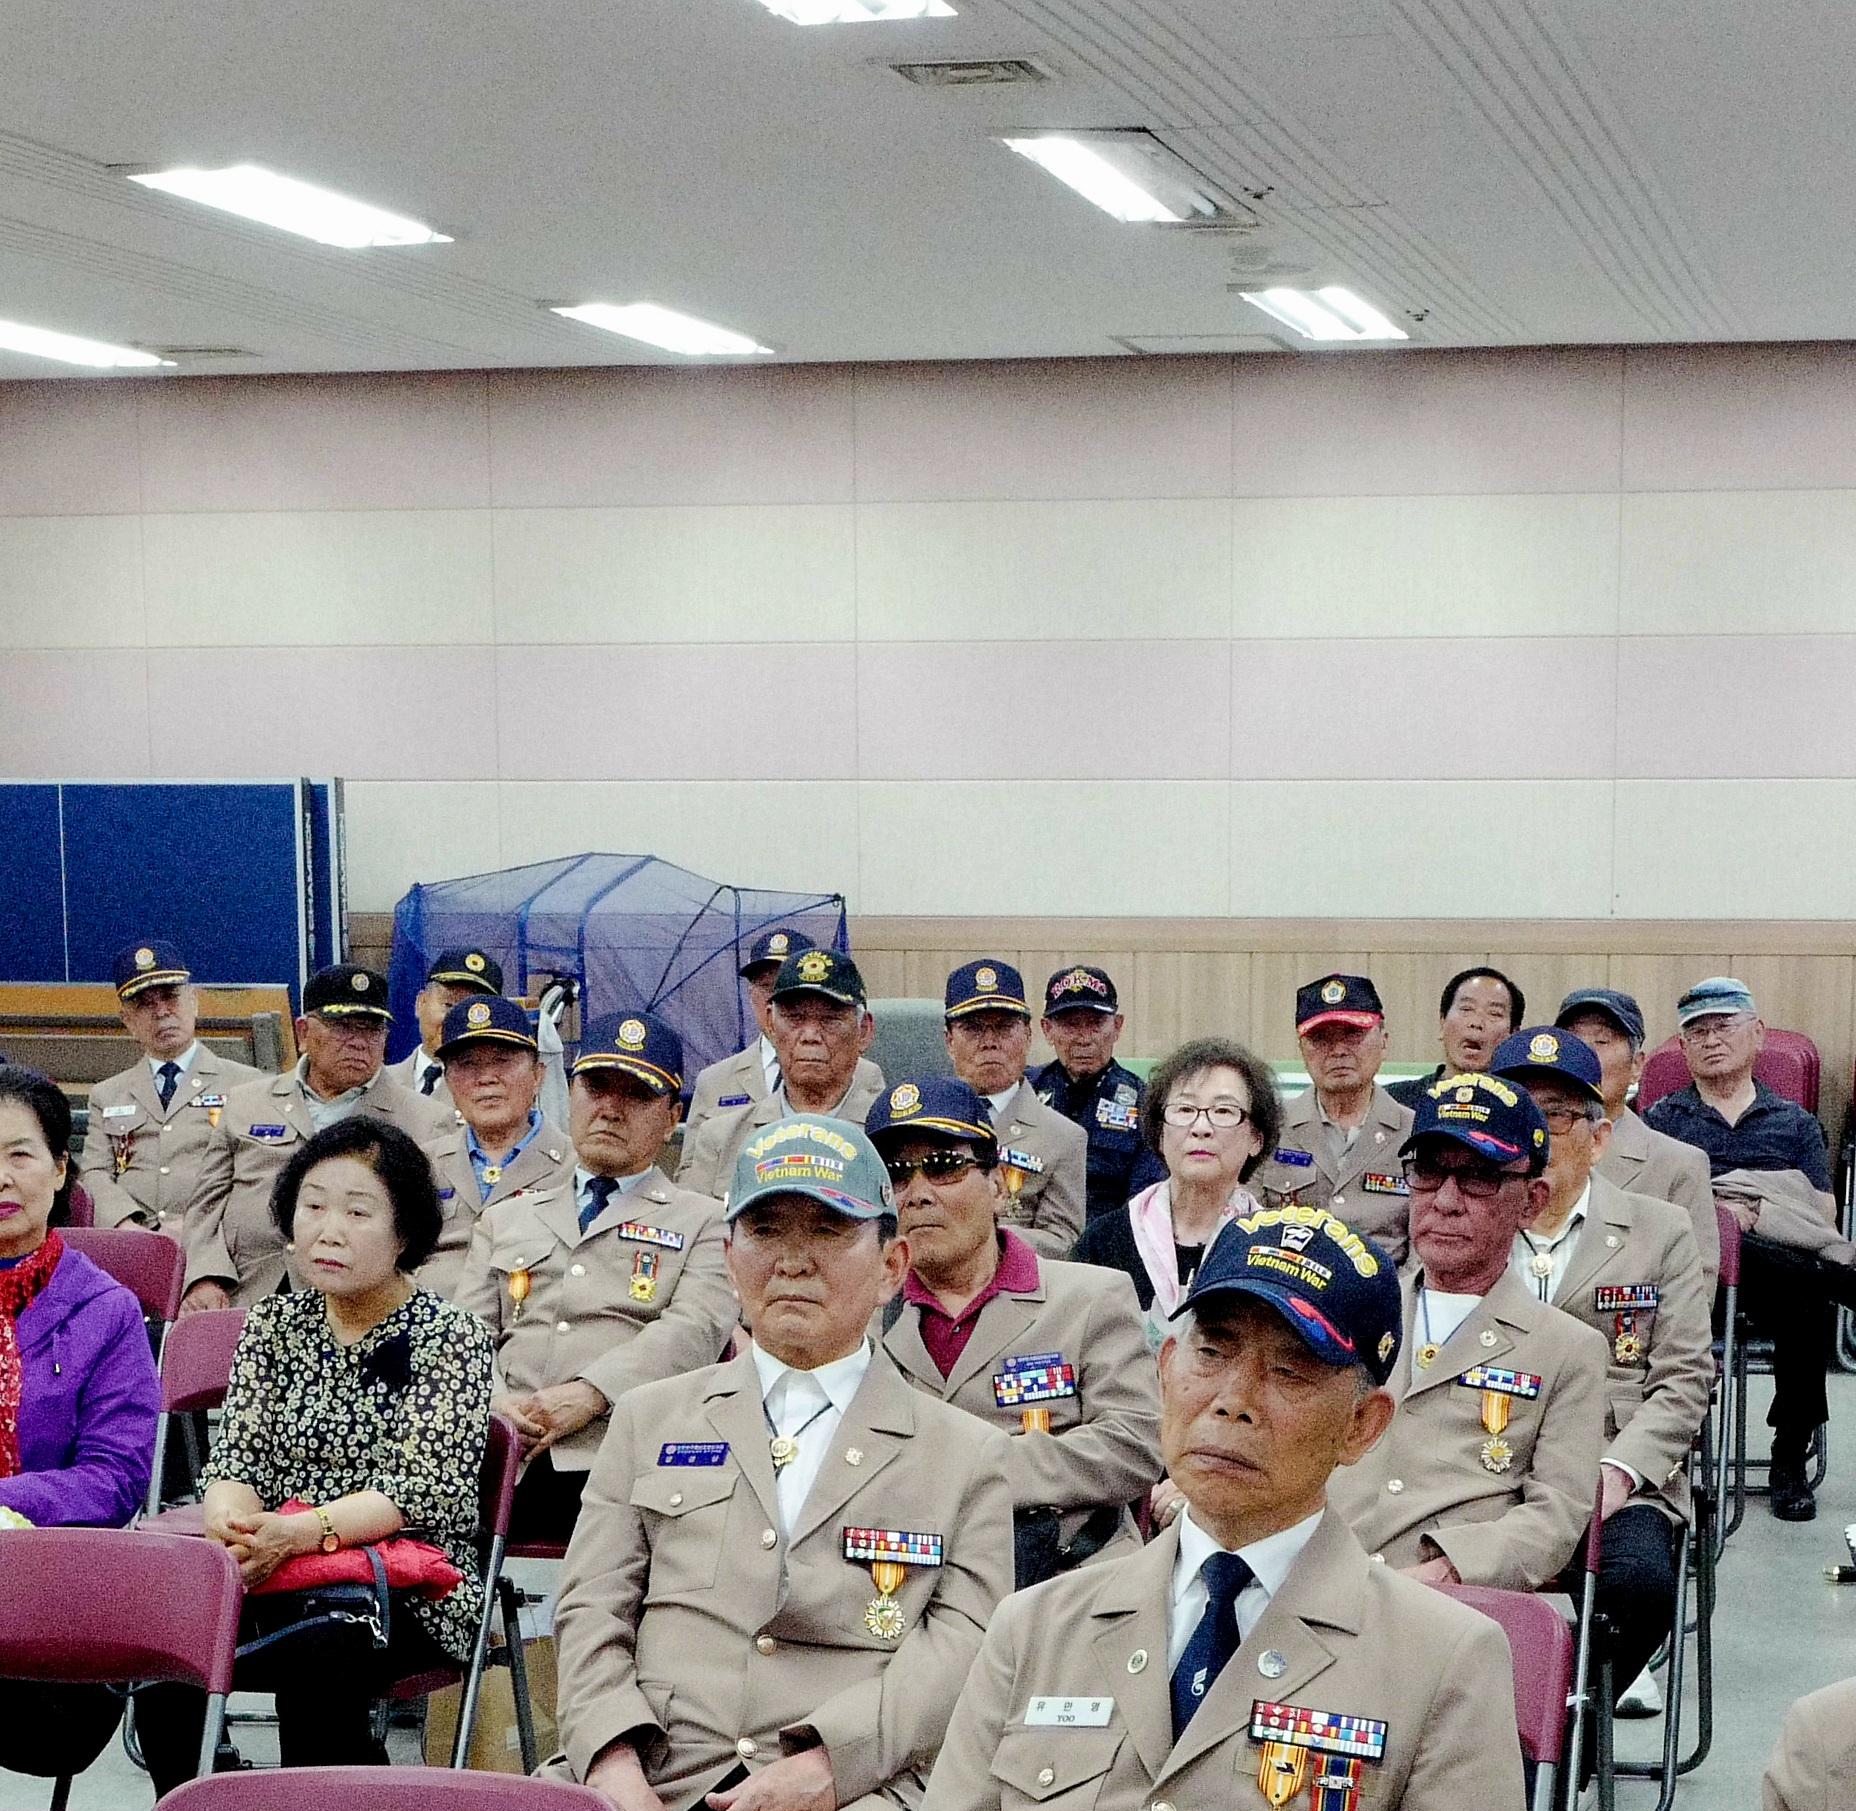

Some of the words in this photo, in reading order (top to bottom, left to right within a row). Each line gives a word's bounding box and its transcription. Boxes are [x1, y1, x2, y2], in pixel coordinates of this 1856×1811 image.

[746, 1123, 857, 1160] Veterans
[757, 1166, 812, 1184] Vietnam
[814, 1166, 843, 1182] War
[1236, 1205, 1378, 1278] Veterans
[1247, 1254, 1300, 1278] Vietnam
[1300, 1267, 1328, 1290] War
